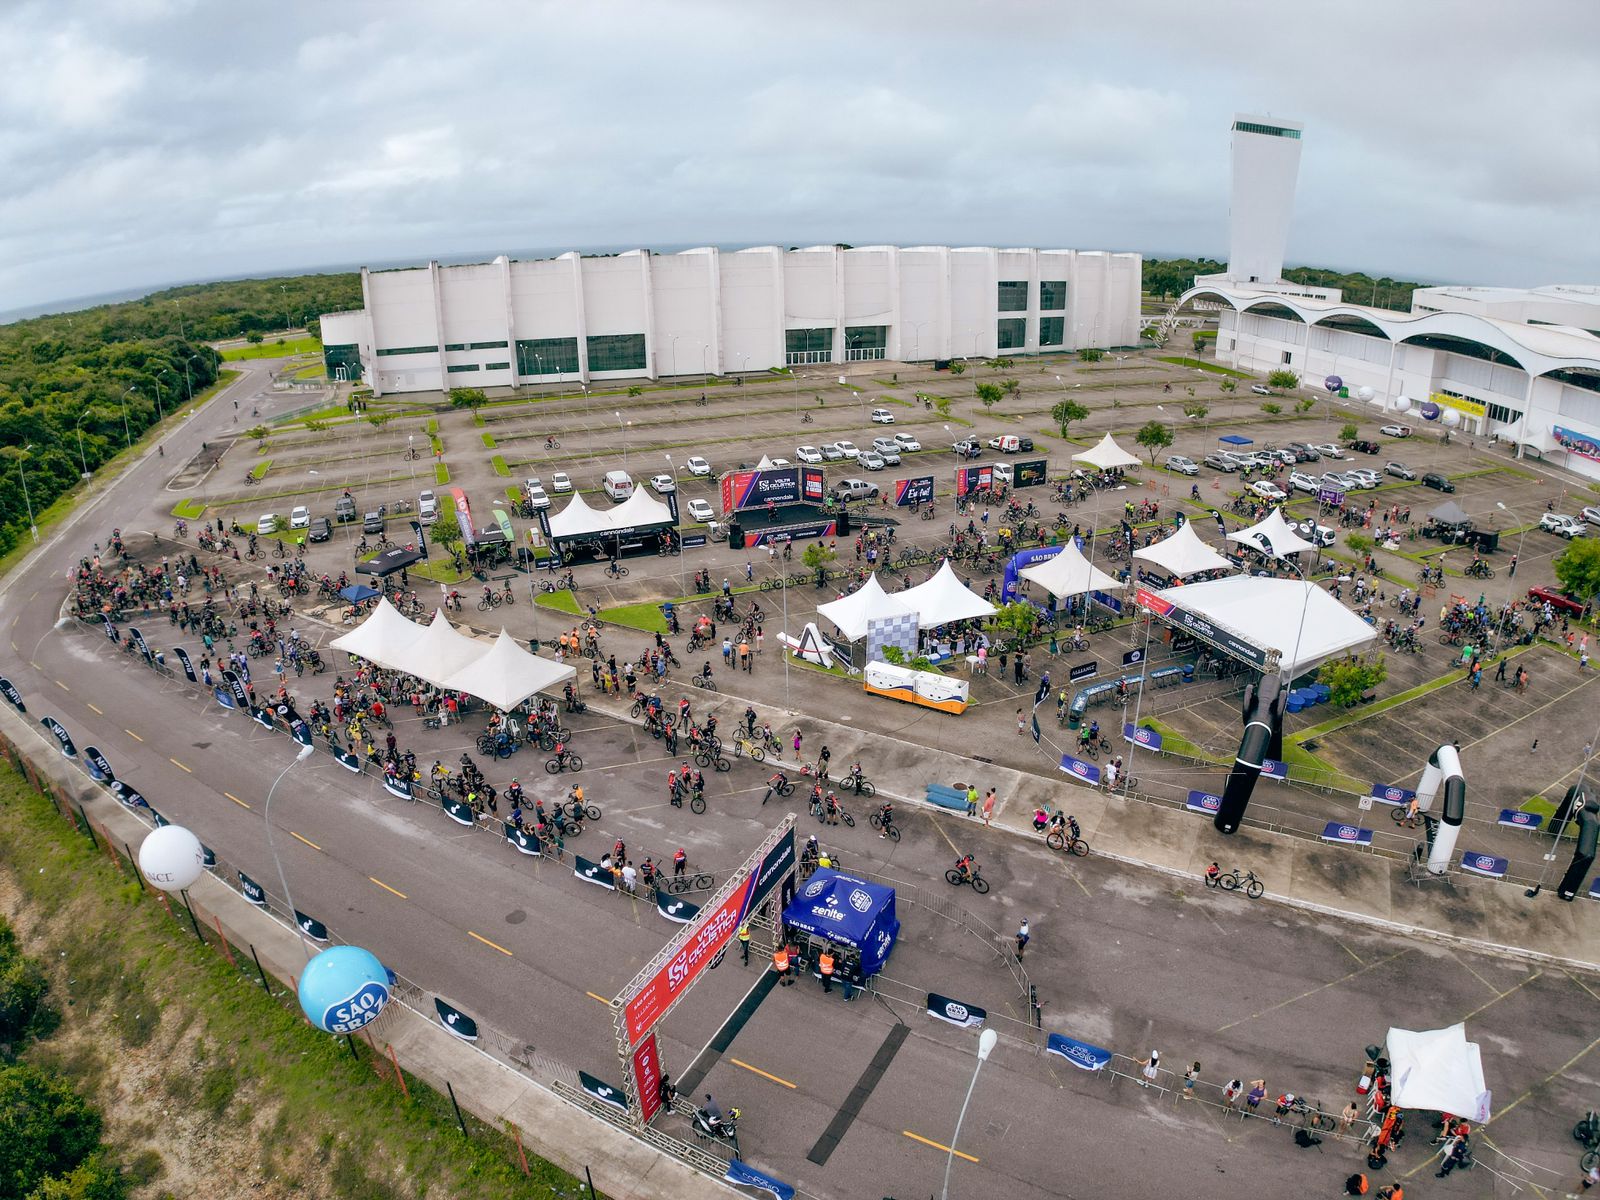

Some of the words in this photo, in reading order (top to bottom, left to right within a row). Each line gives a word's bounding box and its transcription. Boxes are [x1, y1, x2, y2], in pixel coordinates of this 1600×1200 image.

[600, 527, 635, 537] cannondale
[1228, 640, 1257, 658] cannondale
[182, 656, 193, 673] RUN
[8, 687, 22, 705] RUN
[231, 680, 244, 699] RUN
[52, 724, 70, 741] RUN
[96, 756, 111, 775] RUN
[394, 778, 407, 790] RUN
[758, 846, 792, 886] cannondale
[245, 882, 260, 897] RUN
[812, 906, 845, 920] zenite
[697, 909, 728, 942] VOLTA
[800, 922, 815, 932] BRAZ
